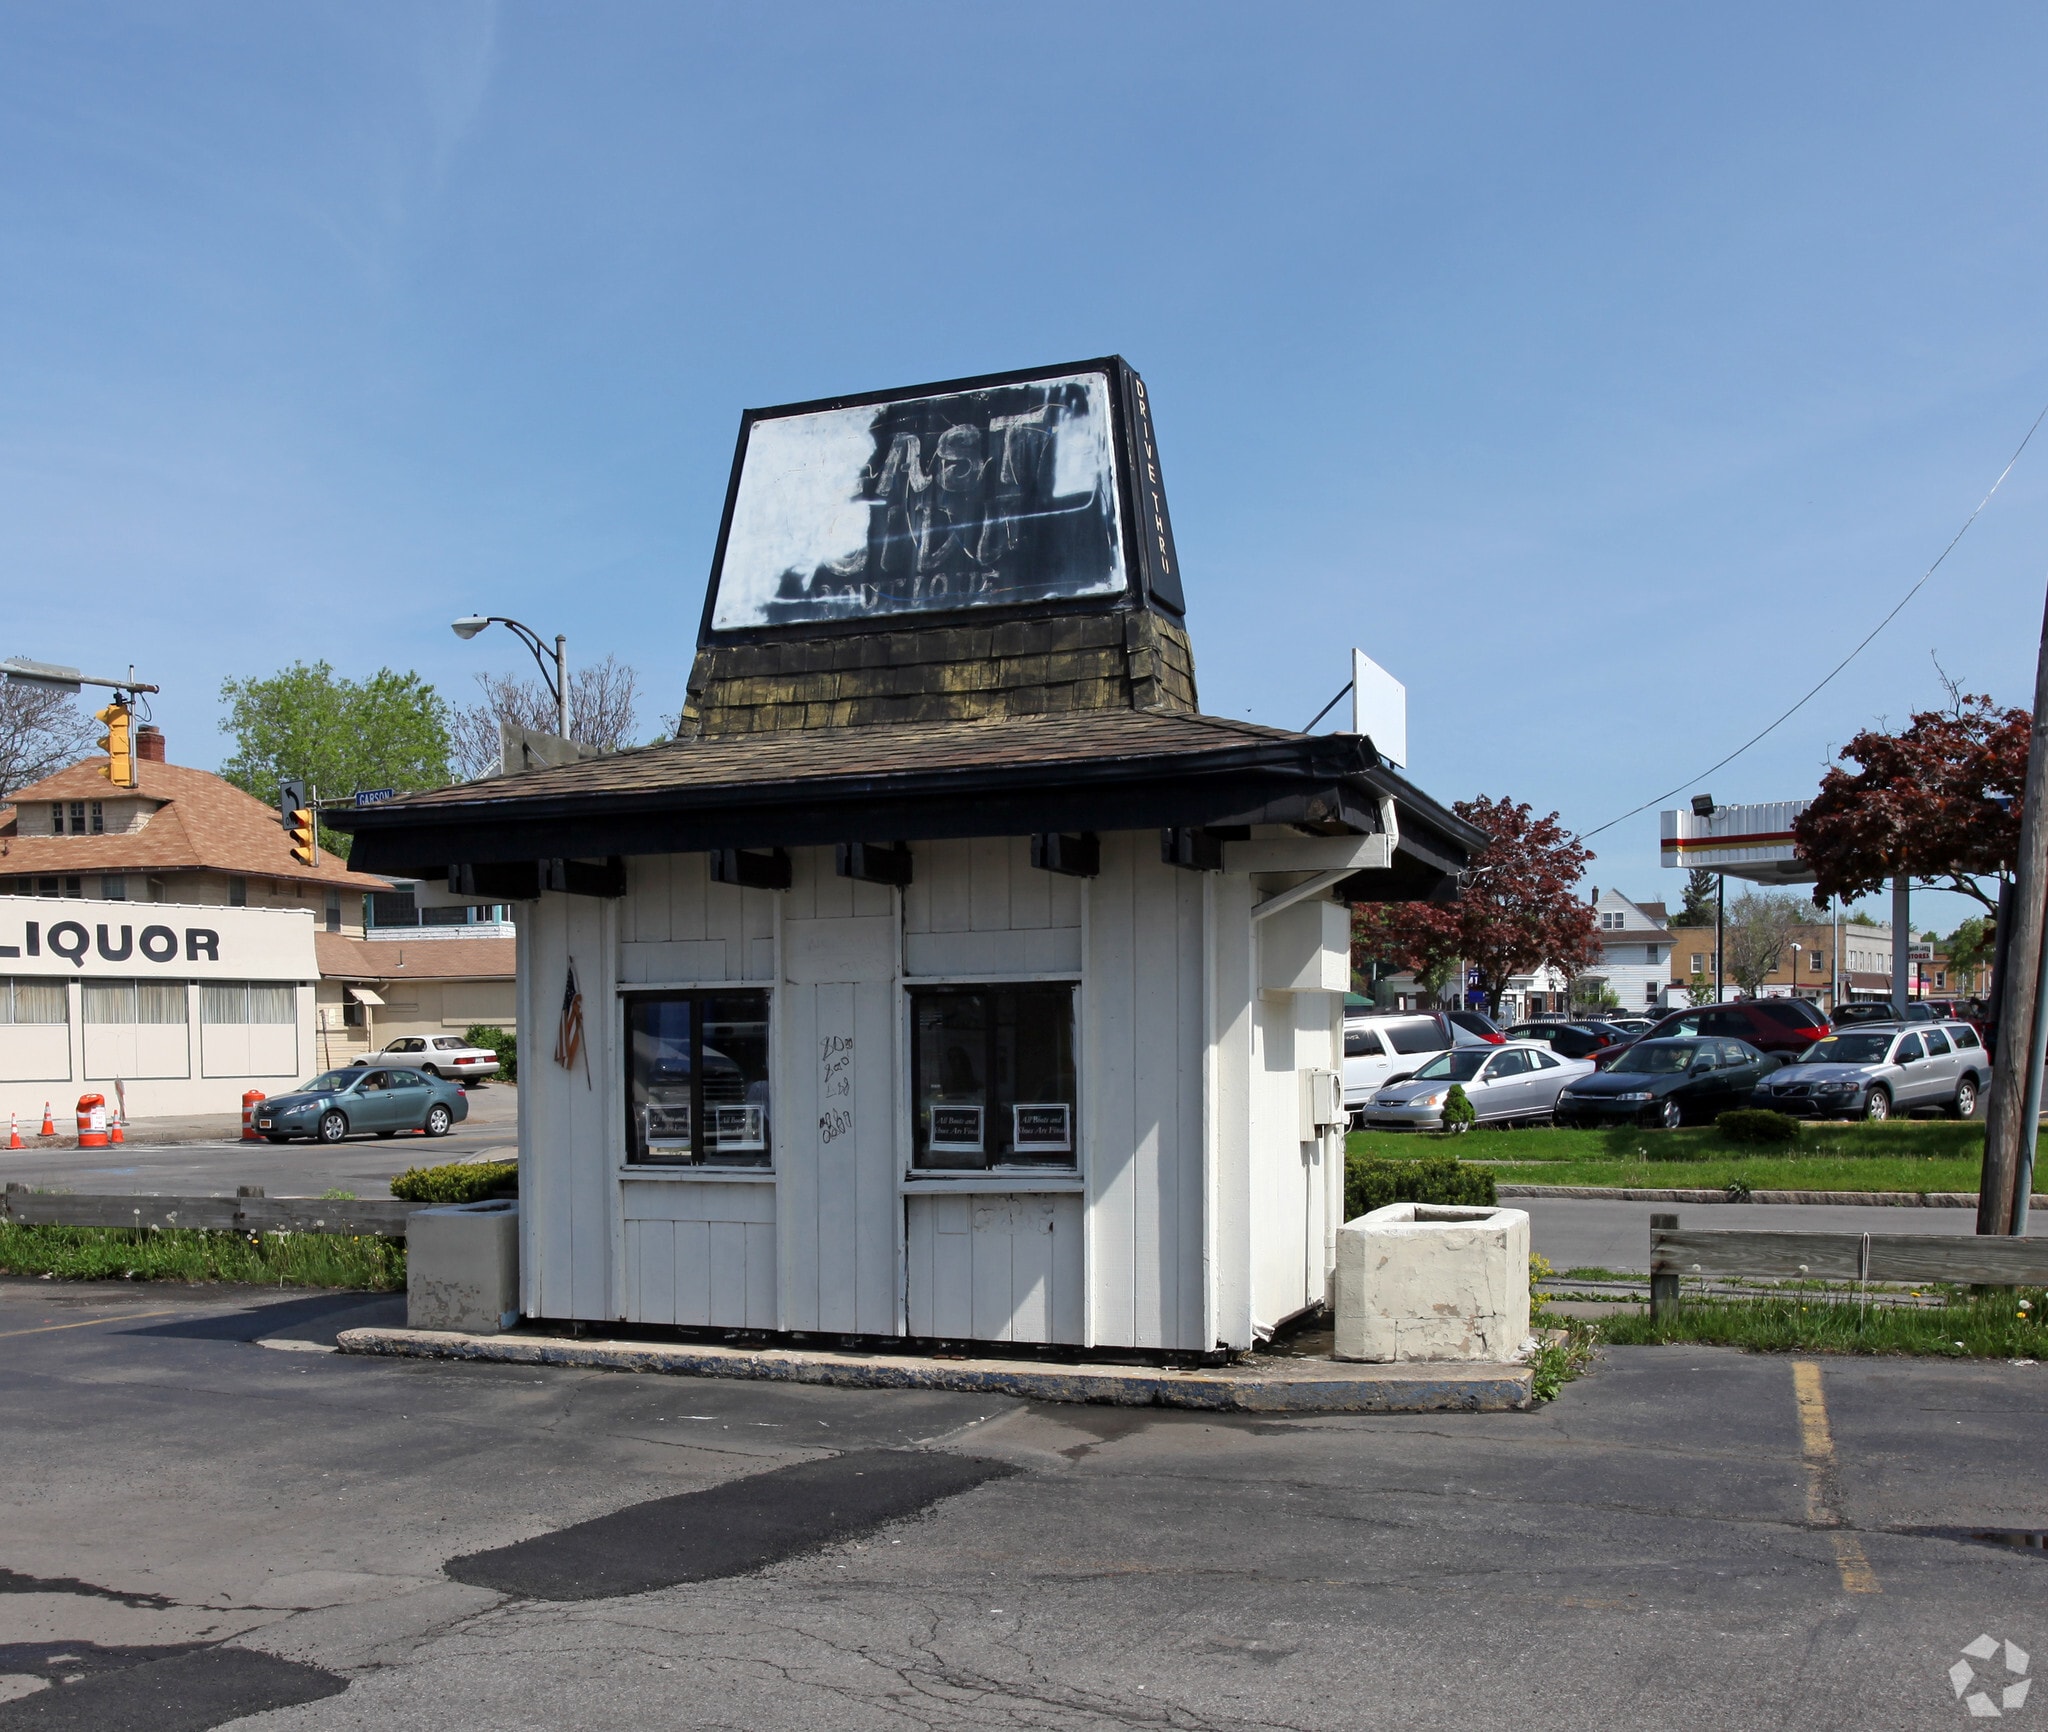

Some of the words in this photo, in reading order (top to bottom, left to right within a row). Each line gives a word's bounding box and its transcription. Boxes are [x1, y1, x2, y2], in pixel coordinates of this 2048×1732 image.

[1135, 378, 1156, 485] DRIVE
[1151, 490, 1170, 575] THRU
[936, 1116, 948, 1124] All
[965, 1117, 977, 1125] and
[1021, 1115, 1033, 1124] All
[1049, 1115, 1063, 1124] and
